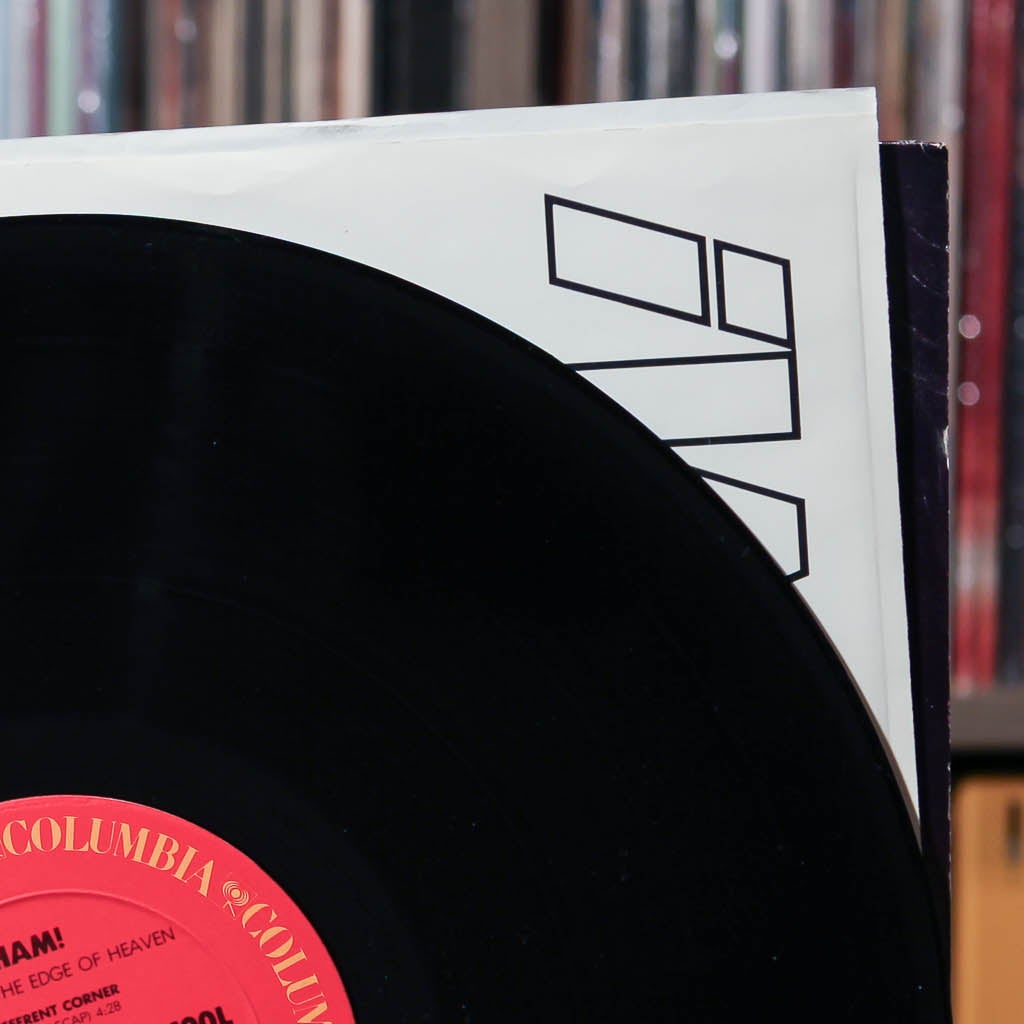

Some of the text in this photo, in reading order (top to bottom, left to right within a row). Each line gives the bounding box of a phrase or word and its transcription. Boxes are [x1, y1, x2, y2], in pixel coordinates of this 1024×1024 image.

[28, 962, 73, 989] EDGE
[78, 951, 101, 972] OF
[106, 926, 176, 962] HEAVEN
[62, 983, 121, 1012] CORNER
[96, 1000, 122, 1017] 4:28
